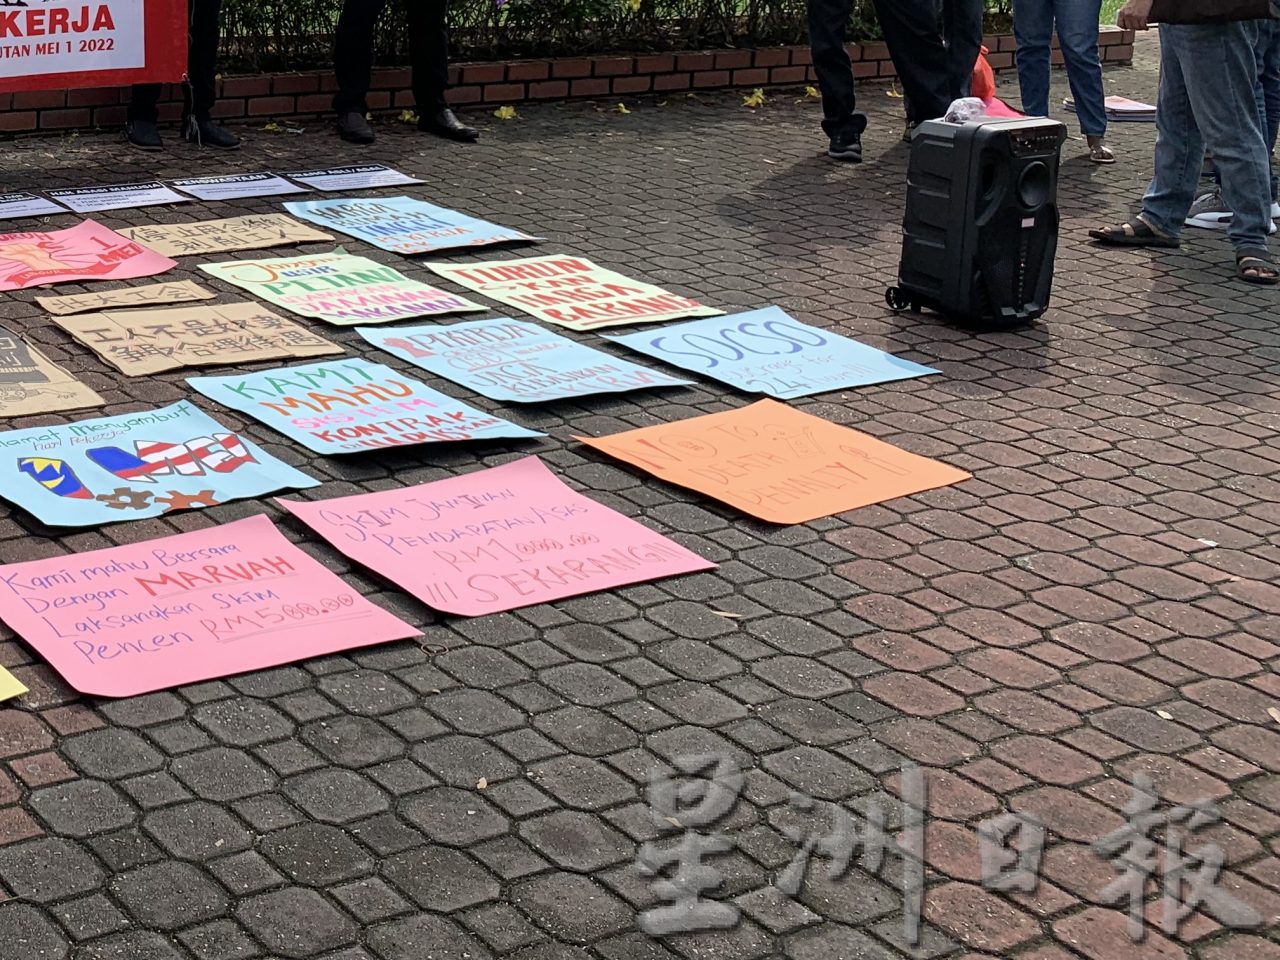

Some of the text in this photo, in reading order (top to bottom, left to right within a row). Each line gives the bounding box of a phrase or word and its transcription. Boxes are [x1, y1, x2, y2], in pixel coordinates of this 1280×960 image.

[35, 42, 61, 56] MEI
[65, 41, 73, 53] 1
[79, 38, 115, 53] 2022
[109, 183, 161, 193] MANUSIA
[306, 202, 401, 221] HARGA
[346, 217, 458, 238] TINGGI
[89, 236, 119, 251] 1
[96, 242, 145, 263] MEI
[261, 267, 410, 295] PETANI
[445, 258, 594, 285] TURUN
[300, 289, 450, 313] JAMINAN
[507, 283, 645, 308] HARGA
[542, 292, 703, 321] BARANG
[650, 320, 828, 368] SOCSO
[259, 378, 414, 417] MAHU
[746, 376, 811, 395] 24
[68, 403, 193, 440] Menyambut
[310, 411, 478, 443] KONTRAK
[608, 422, 760, 470] NO TO
[688, 450, 793, 486] DEATH
[725, 461, 869, 506] PENALTY
[320, 488, 516, 542] SKIM JAMINAN
[372, 515, 536, 556] PENDAPATAN
[85, 559, 150, 581] mahu
[152, 542, 241, 568] Bersara
[22, 588, 128, 615] Dengan
[42, 602, 203, 639] Laksanakan
[73, 631, 196, 665] Pencen
